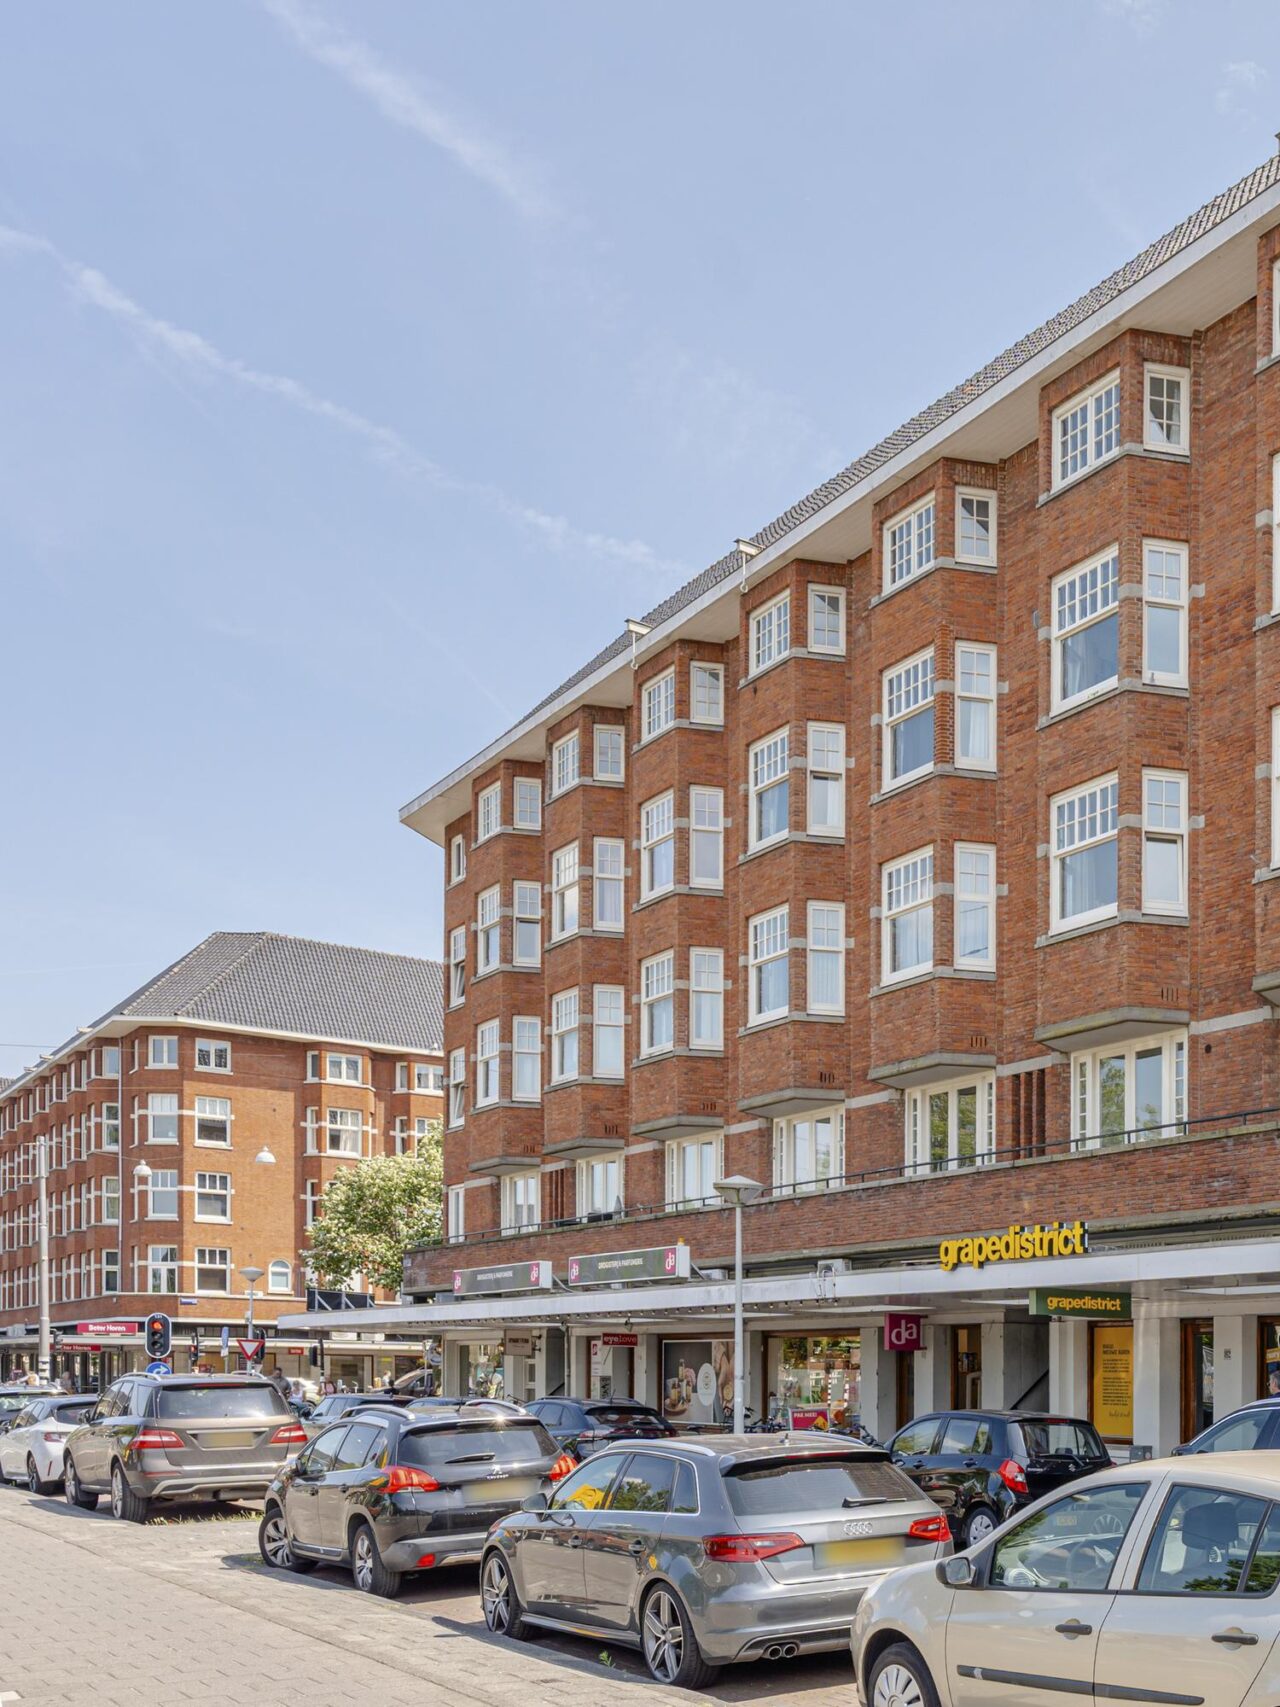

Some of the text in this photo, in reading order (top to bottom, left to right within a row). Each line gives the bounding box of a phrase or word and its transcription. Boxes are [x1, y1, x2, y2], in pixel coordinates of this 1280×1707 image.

[939, 1221, 1087, 1271] grapedistrict
[666, 1252, 675, 1270] da
[1047, 1296, 1121, 1311] grapedistrict
[891, 1319, 918, 1345] da
